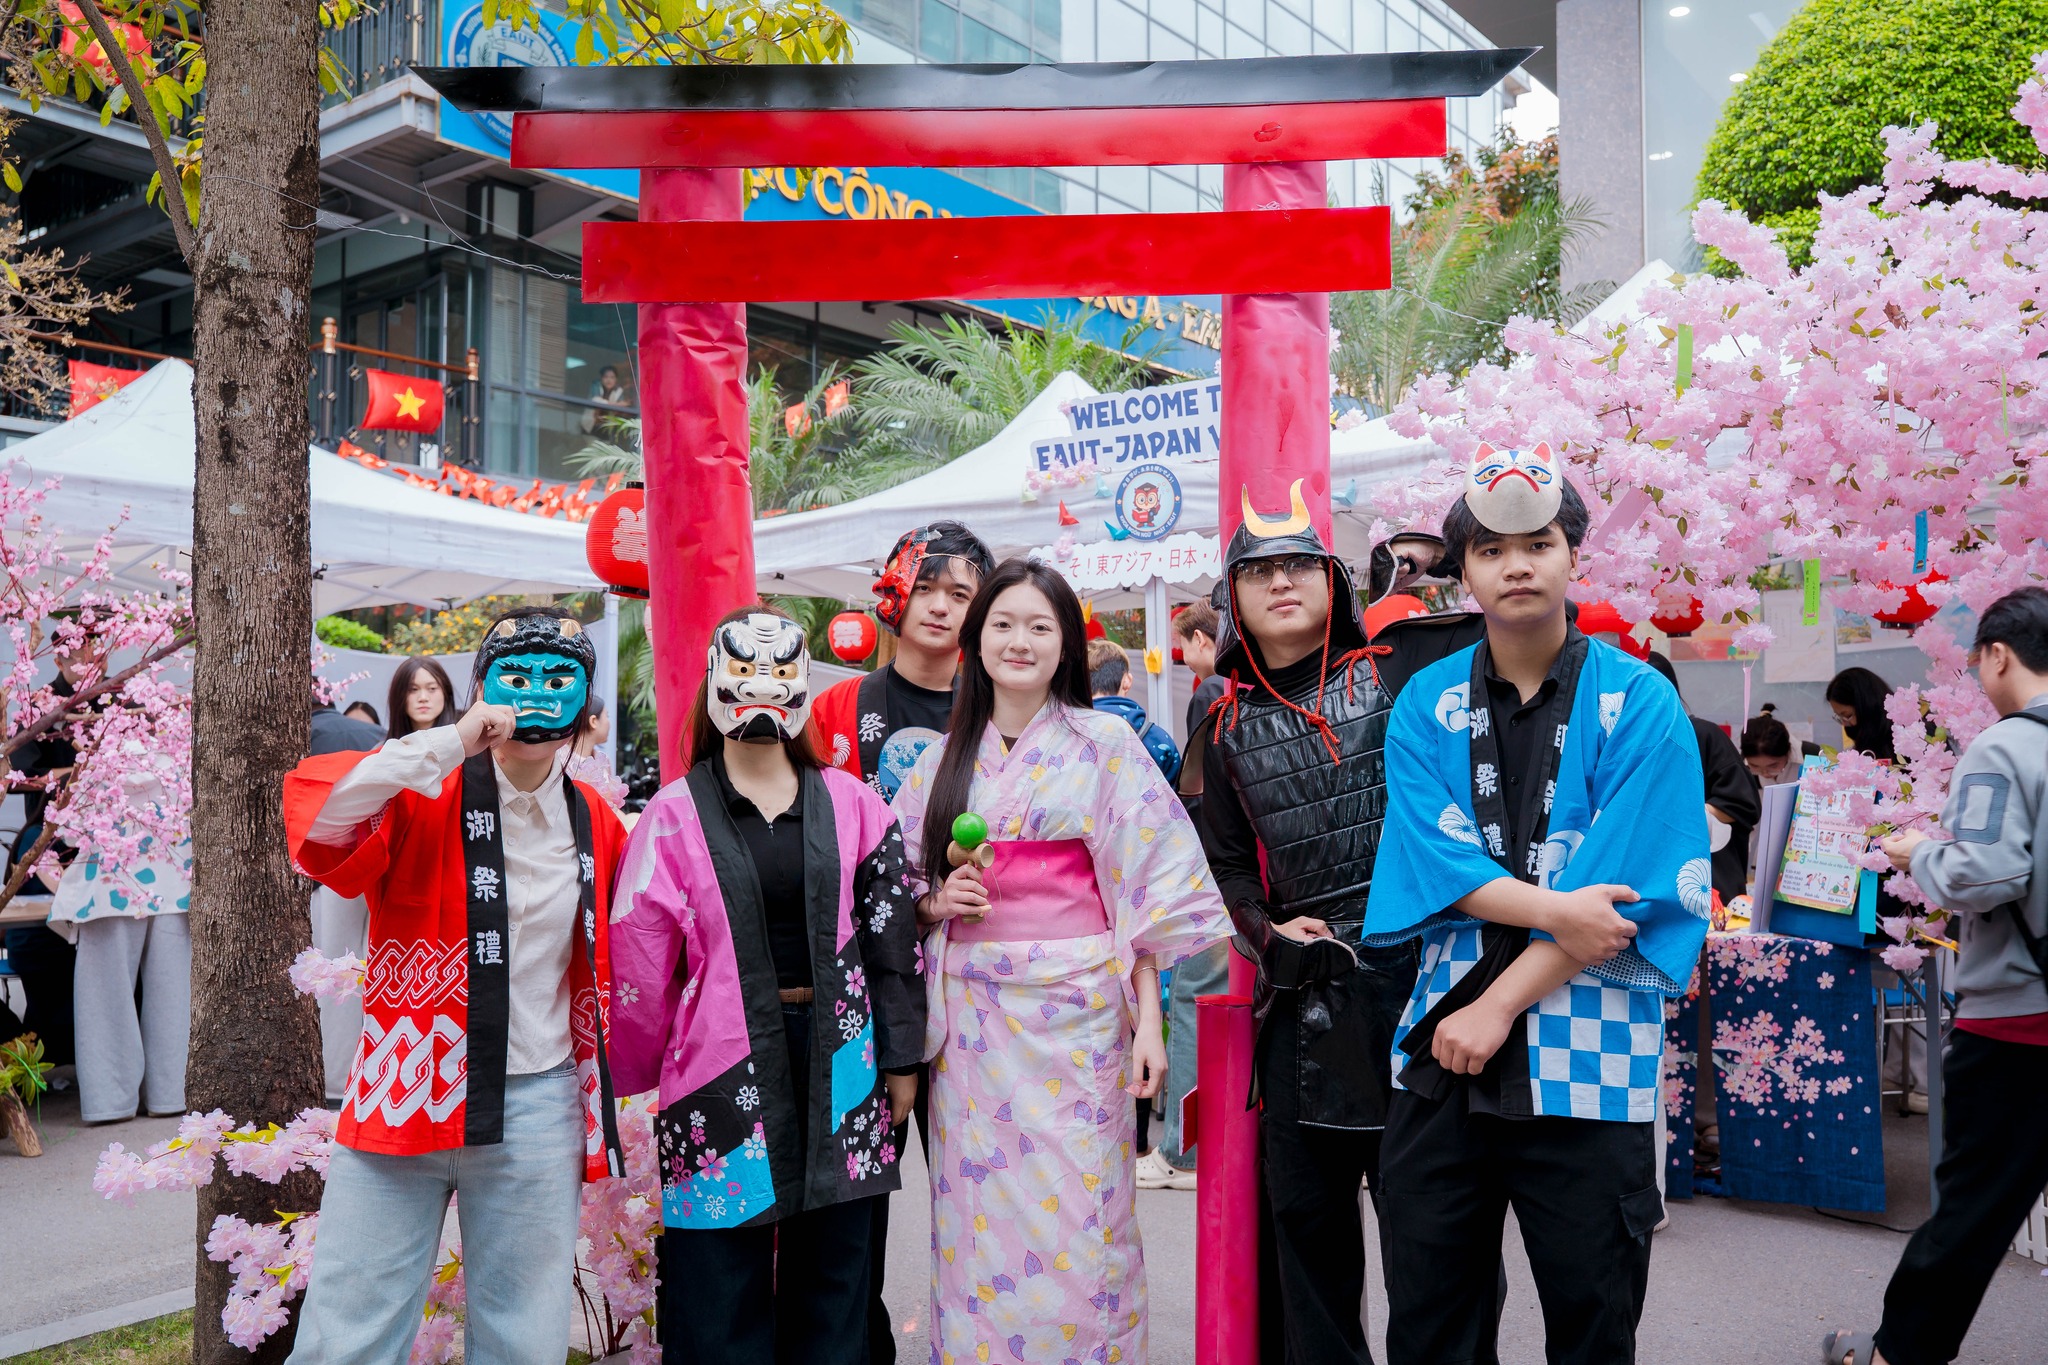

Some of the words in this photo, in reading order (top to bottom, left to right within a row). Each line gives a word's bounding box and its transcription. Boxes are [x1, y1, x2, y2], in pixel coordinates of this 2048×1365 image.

[501, 27, 535, 49] EAUT
[1181, 301, 1222, 350] EA
[1071, 388, 1199, 431] WELCOME
[1206, 385, 1221, 412] T
[1036, 426, 1202, 472] EAUT-JAPAN
[466, 809, 504, 965] 御祭禮
